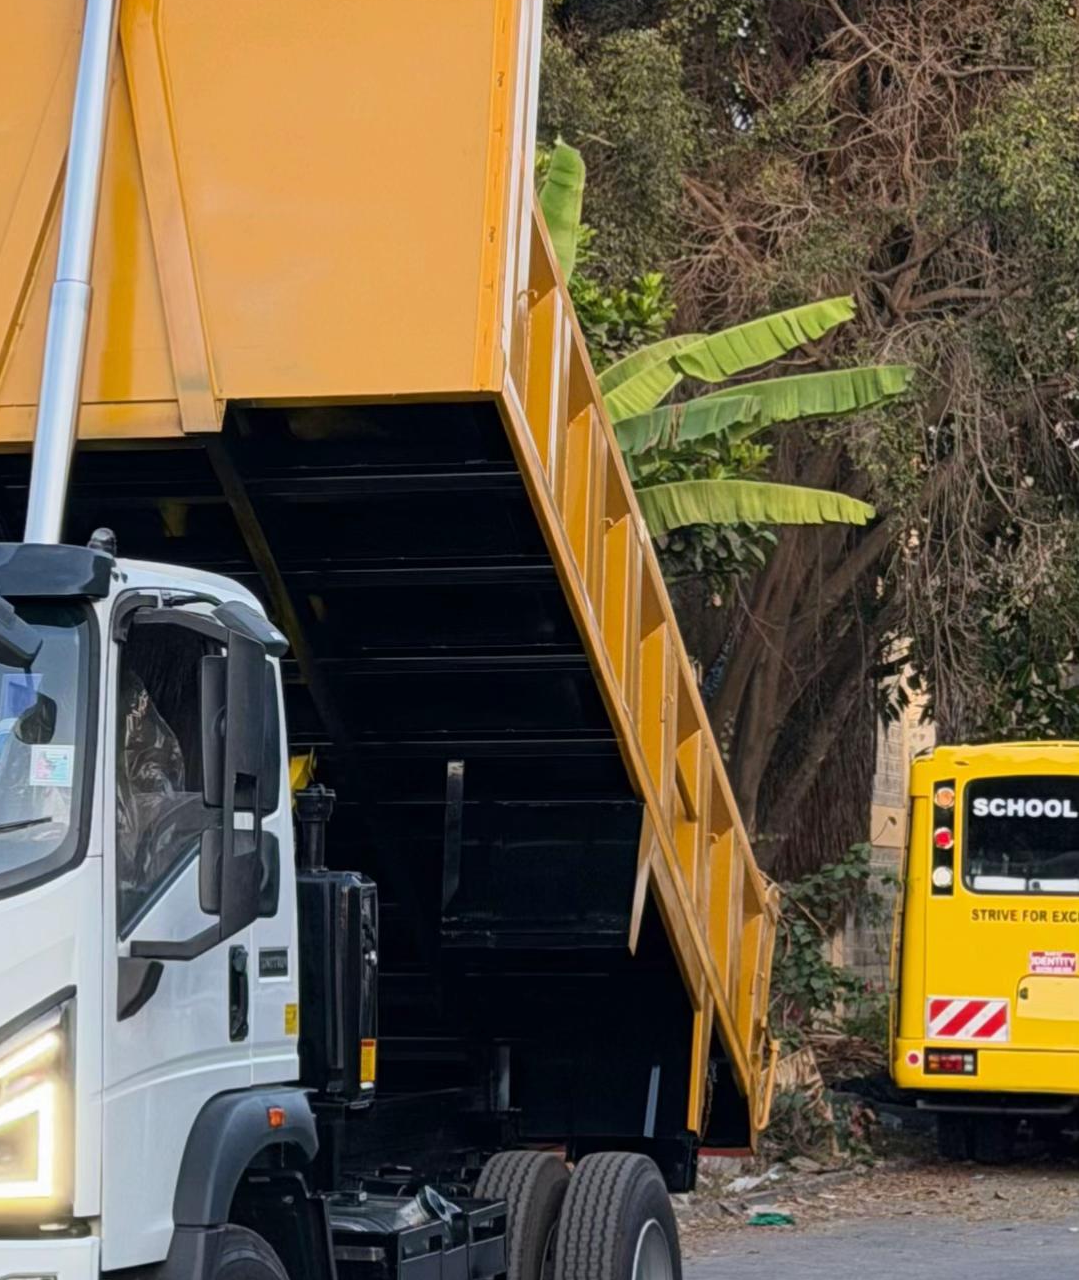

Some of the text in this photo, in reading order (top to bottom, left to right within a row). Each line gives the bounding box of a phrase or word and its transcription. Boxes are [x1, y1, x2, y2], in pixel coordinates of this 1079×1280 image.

[972, 797, 1079, 818] SCHOOL
[971, 908, 1079, 923] STRIVE FOR EXC
